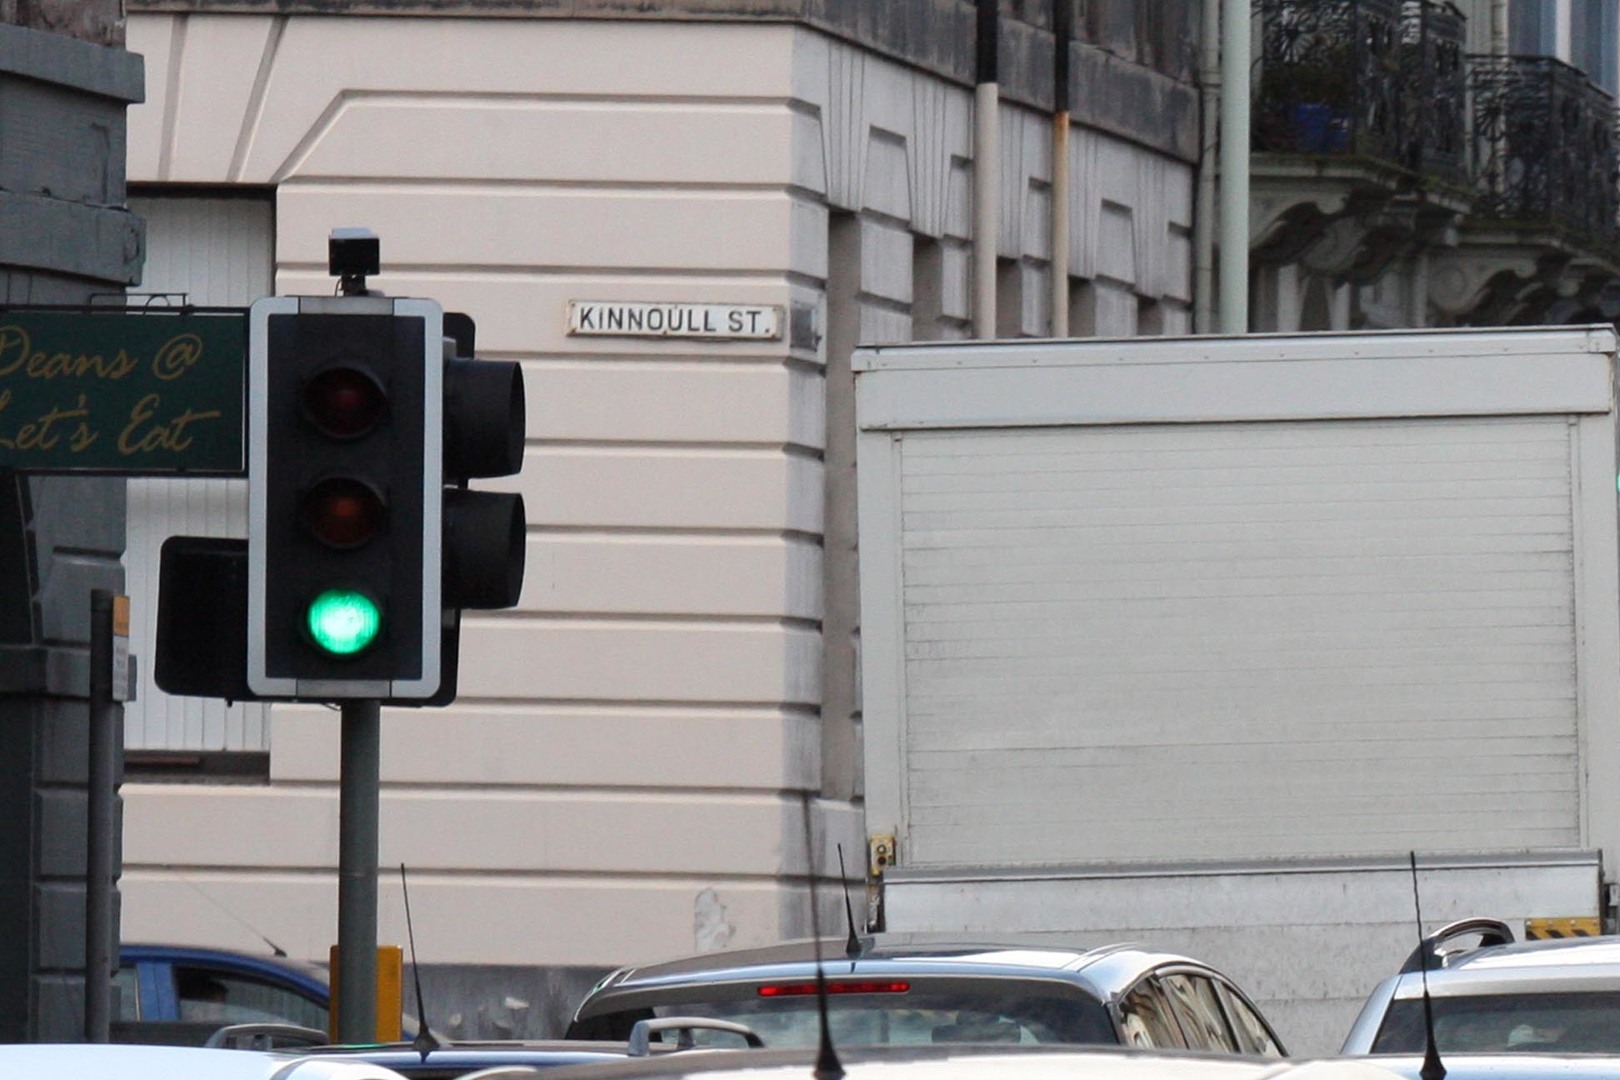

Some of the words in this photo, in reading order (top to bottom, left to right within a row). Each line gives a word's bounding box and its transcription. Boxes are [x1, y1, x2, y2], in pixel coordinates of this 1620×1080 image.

[580, 306, 716, 333] KINNOULL
[728, 310, 771, 334] ST.
[153, 333, 203, 380] @
[118, 394, 221, 455] Eat
